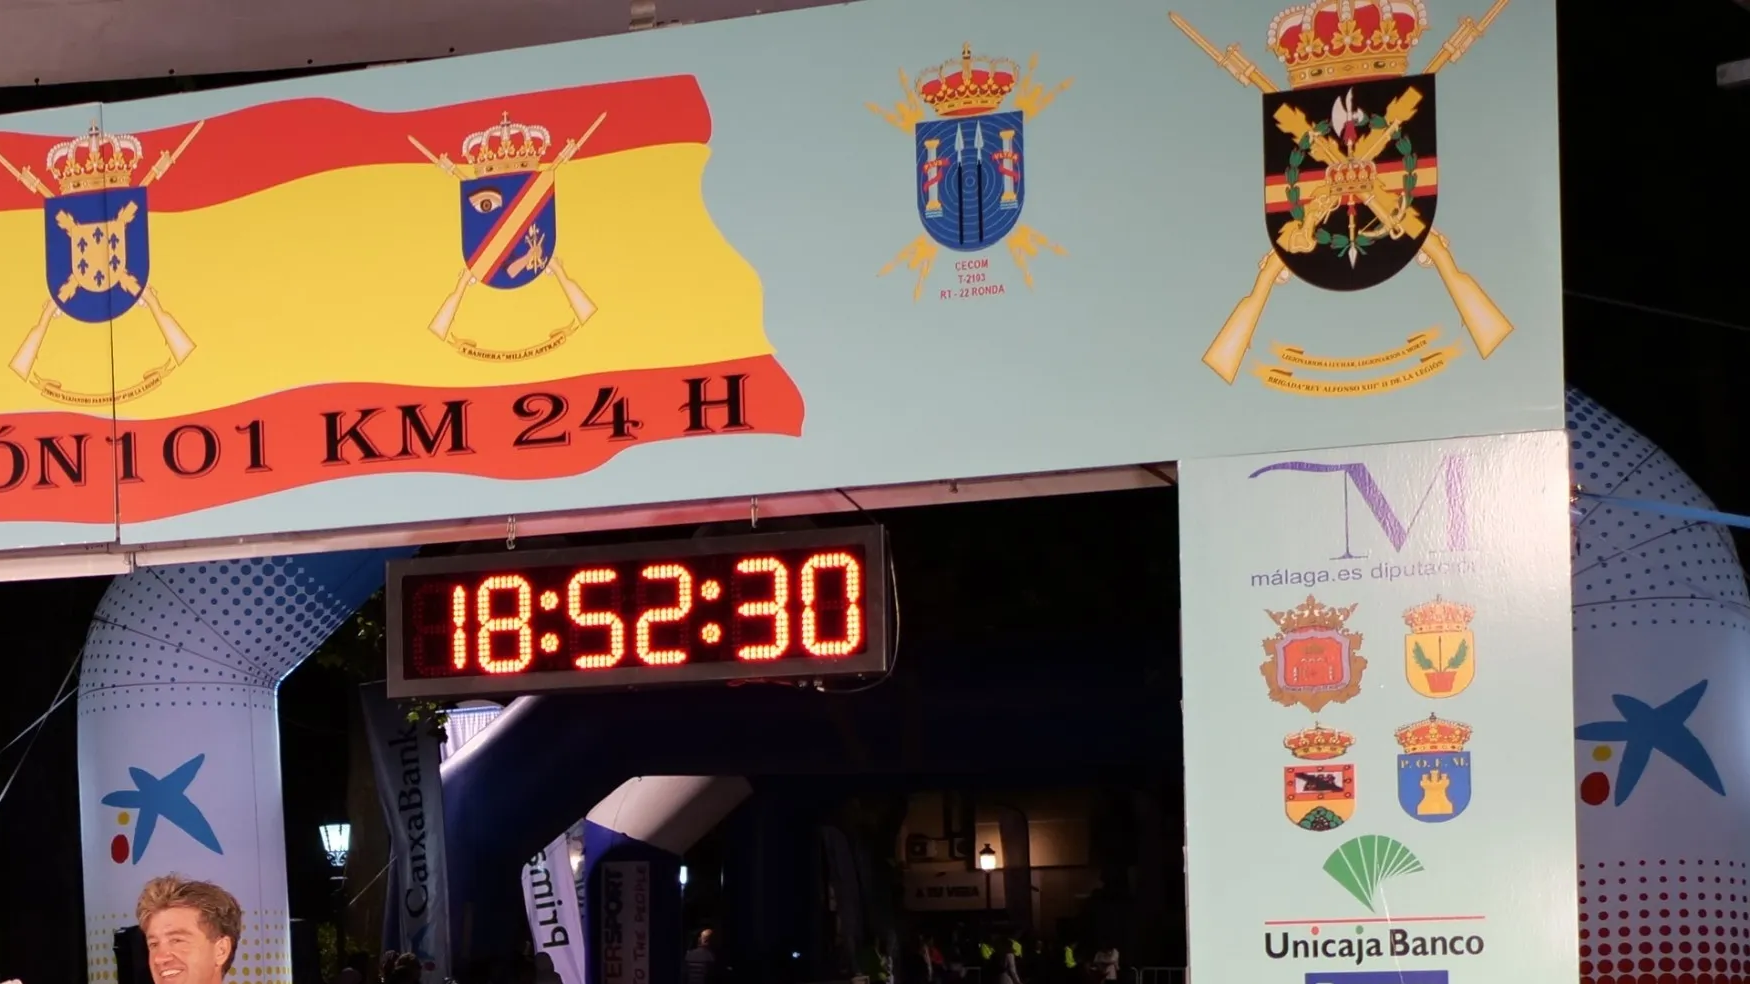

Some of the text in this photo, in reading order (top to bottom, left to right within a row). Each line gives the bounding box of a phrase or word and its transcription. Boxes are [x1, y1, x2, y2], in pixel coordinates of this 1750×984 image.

[955, 259, 989, 271] CECOM
[958, 273, 986, 284] T-2103
[940, 289, 952, 299] RT
[959, 288, 969, 298] 22
[971, 284, 1005, 296] RONDA
[468, 349, 501, 360] BANDERA
[1267, 375, 1302, 390] BRIGADA
[1323, 383, 1360, 393] ALFONSO
[1390, 378, 1400, 386] DE
[1403, 373, 1413, 382] LA
[1415, 360, 1444, 378] LEGIÓN
[106, 420, 275, 485] 101
[319, 400, 476, 467] KM
[512, 385, 645, 450] 24
[682, 373, 754, 435] H
[1251, 567, 1362, 588] málaga.es
[450, 550, 861, 675] 18:52:30
[1264, 926, 1485, 965] Unicaja Banco
